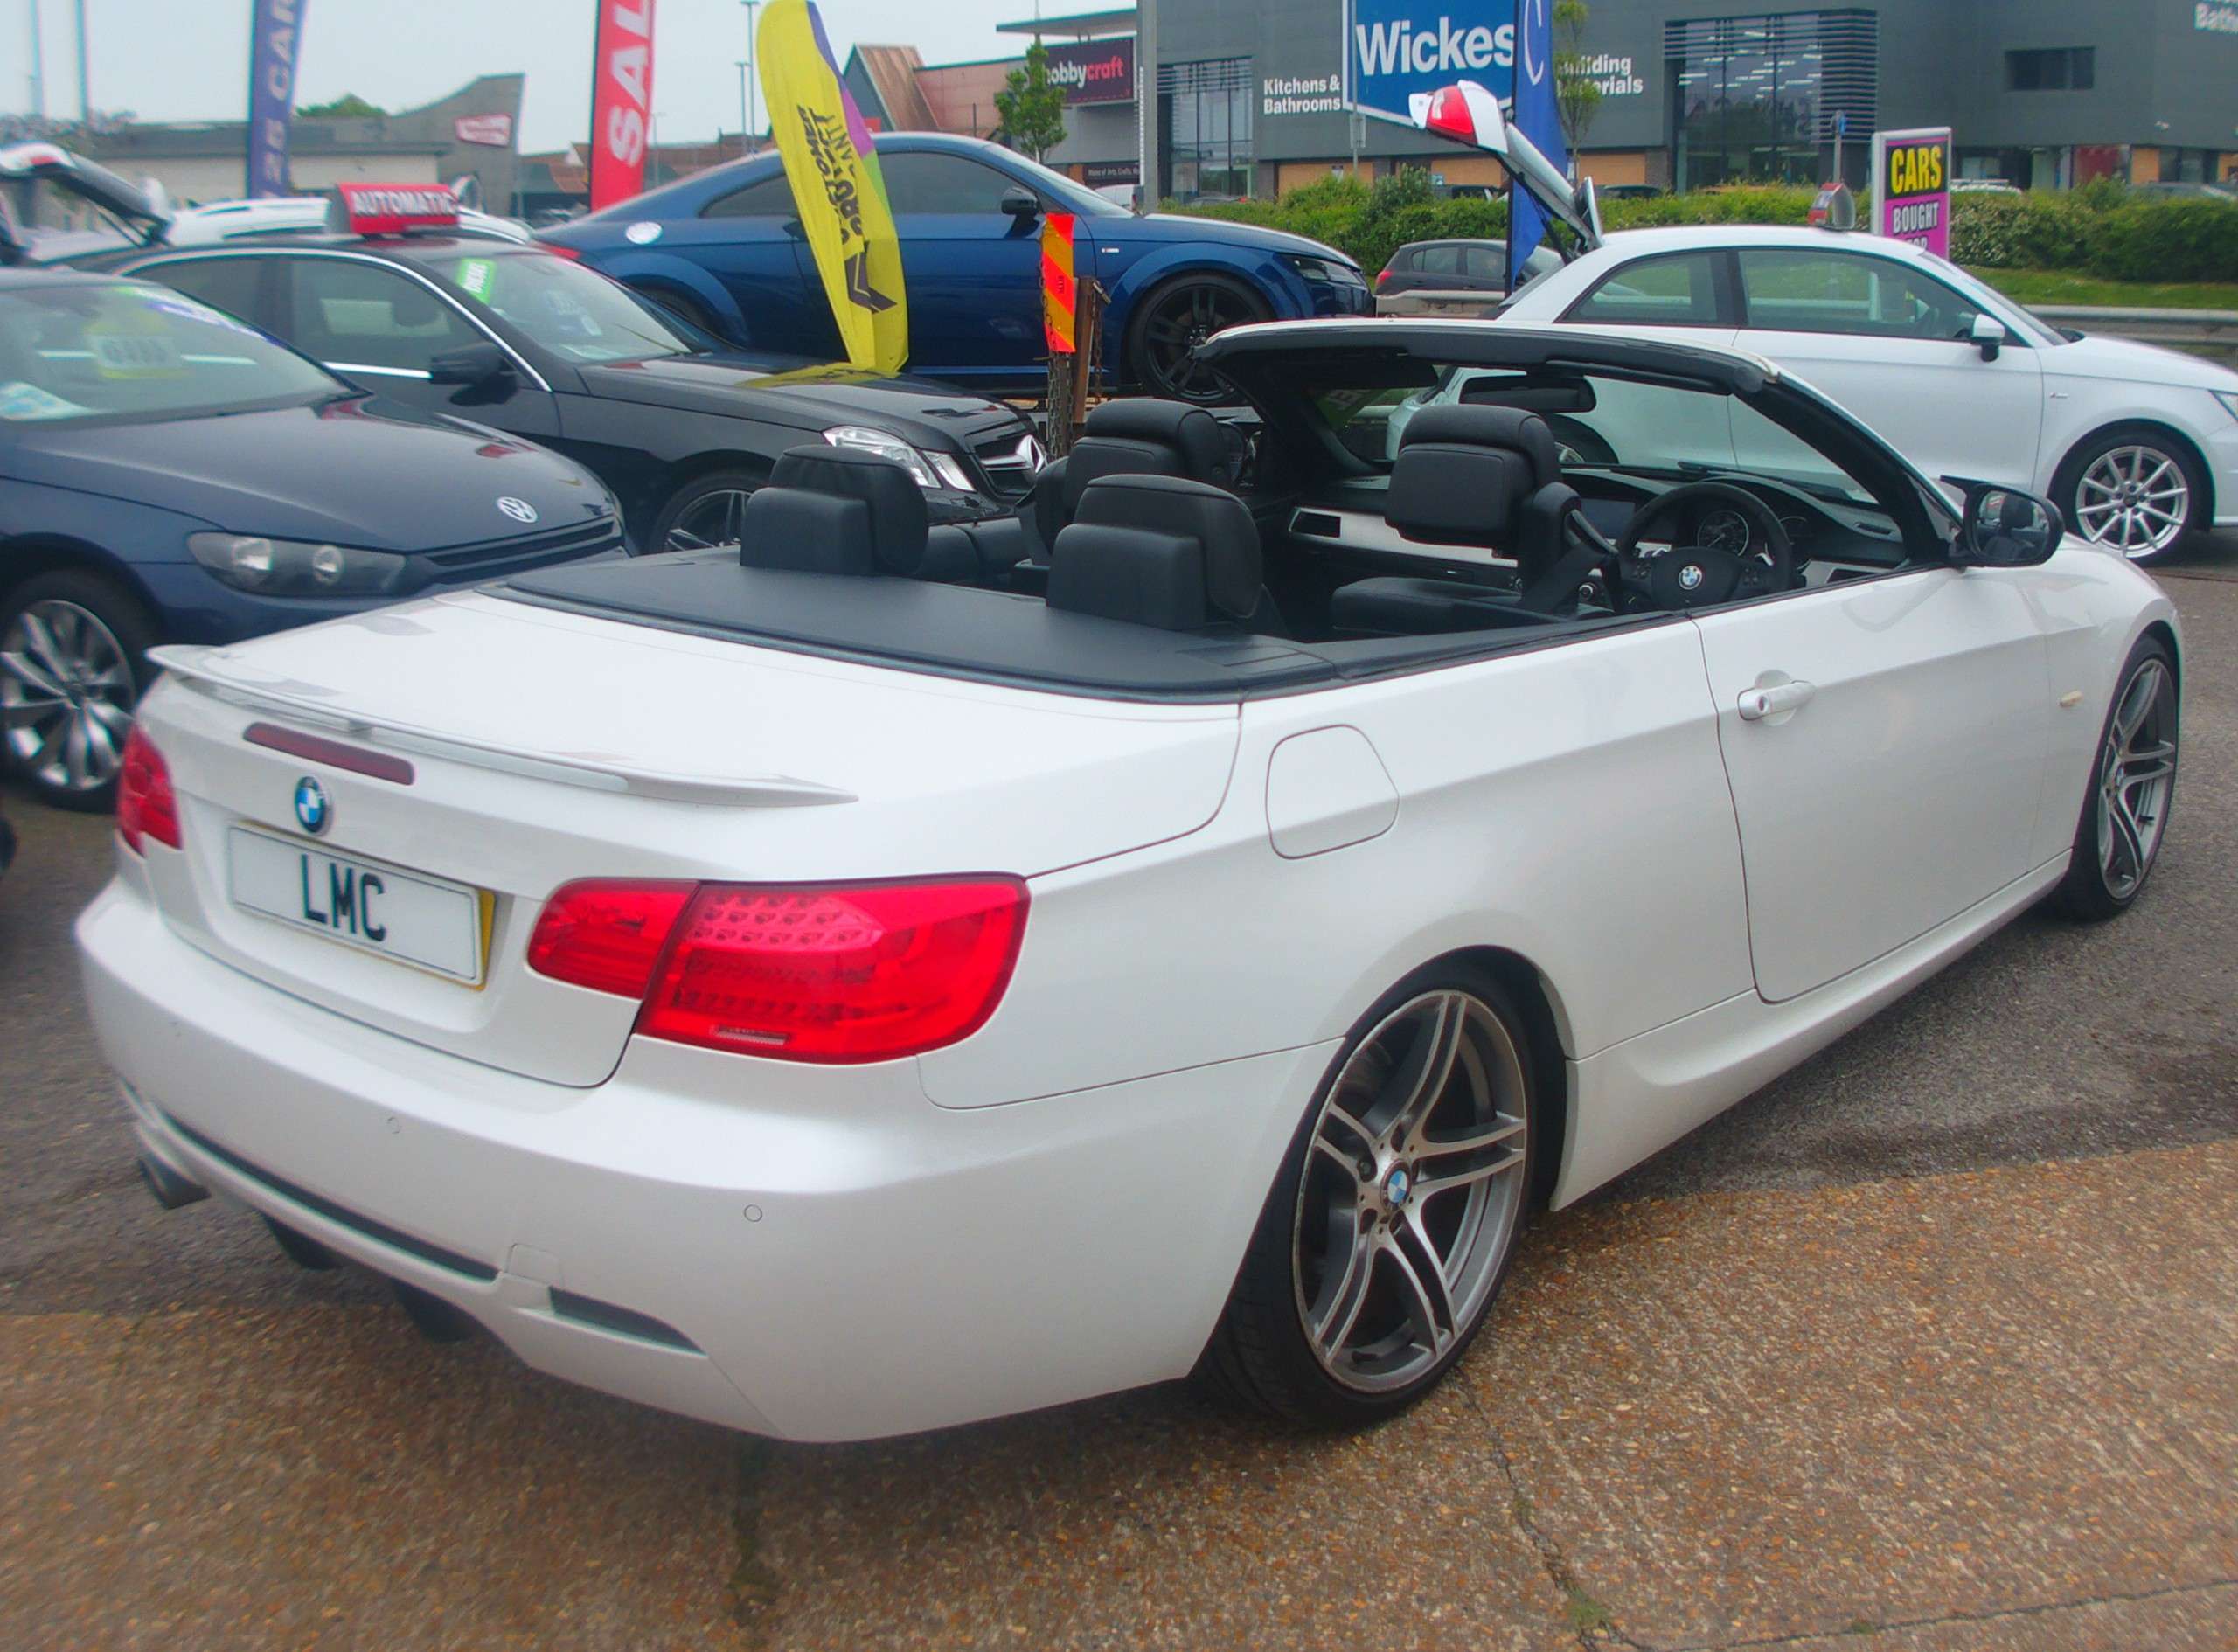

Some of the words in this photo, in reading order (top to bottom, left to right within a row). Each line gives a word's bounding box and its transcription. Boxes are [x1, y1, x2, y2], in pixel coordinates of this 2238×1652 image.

[1356, 17, 1514, 76] Wickes
[1559, 54, 1631, 76] ilding
[1264, 76, 1326, 95] Kitchens
[1329, 74, 1340, 92] &
[1557, 75, 1644, 97] erials
[1264, 96, 1340, 115] Bathrooms
[1891, 145, 1942, 194] CARS
[351, 190, 457, 216] AUTOMATIC
[1894, 202, 1939, 235] BOUGHT
[301, 853, 386, 942] LMC
